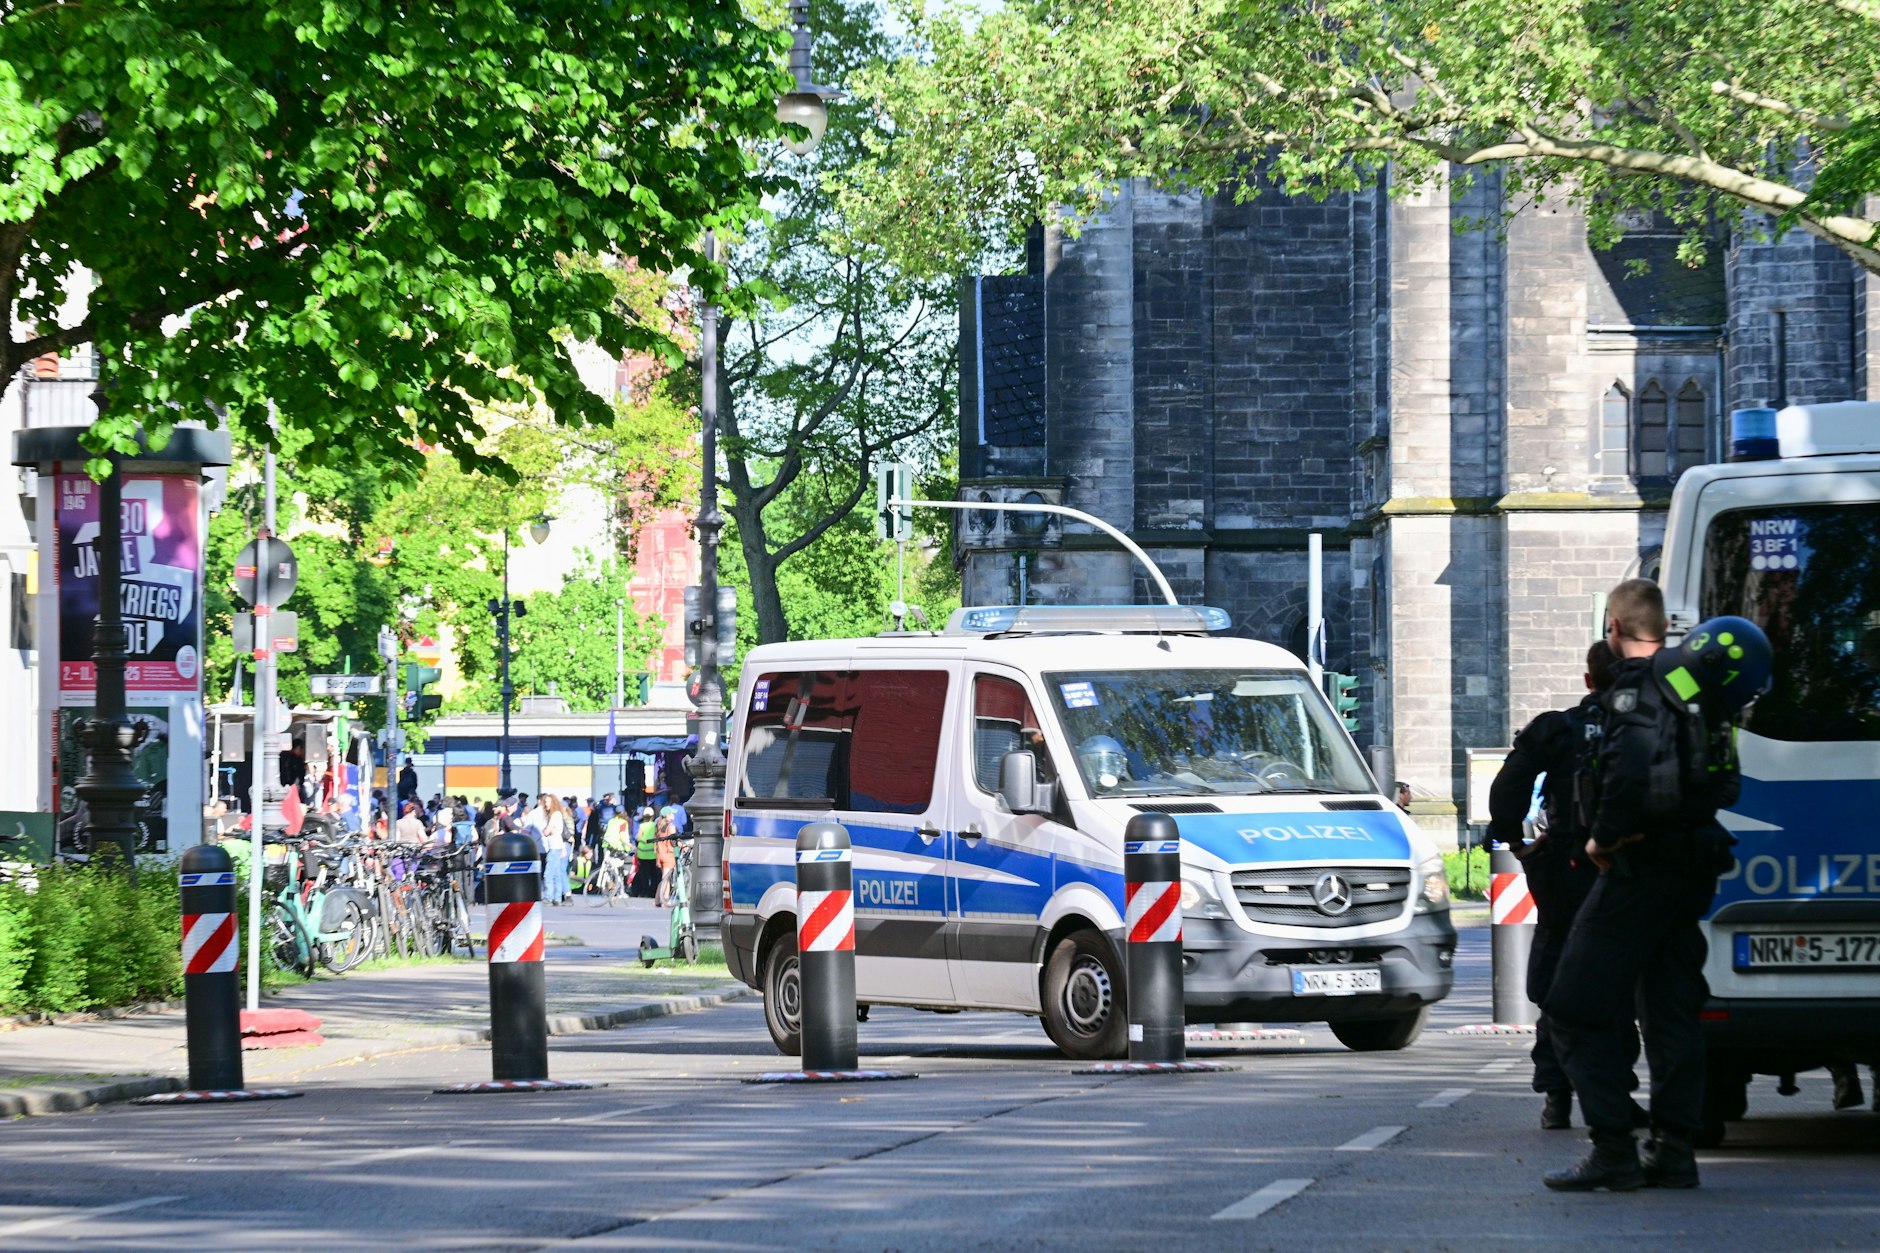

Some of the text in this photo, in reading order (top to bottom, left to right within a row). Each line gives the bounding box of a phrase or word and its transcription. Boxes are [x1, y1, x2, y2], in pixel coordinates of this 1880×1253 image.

[1751, 519, 1797, 536] NRW
[1690, 632, 1711, 652] 3
[1236, 825, 1375, 844] POLIZEI
[859, 879, 919, 906] POLIZEI
[1750, 937, 1794, 963] NRW
